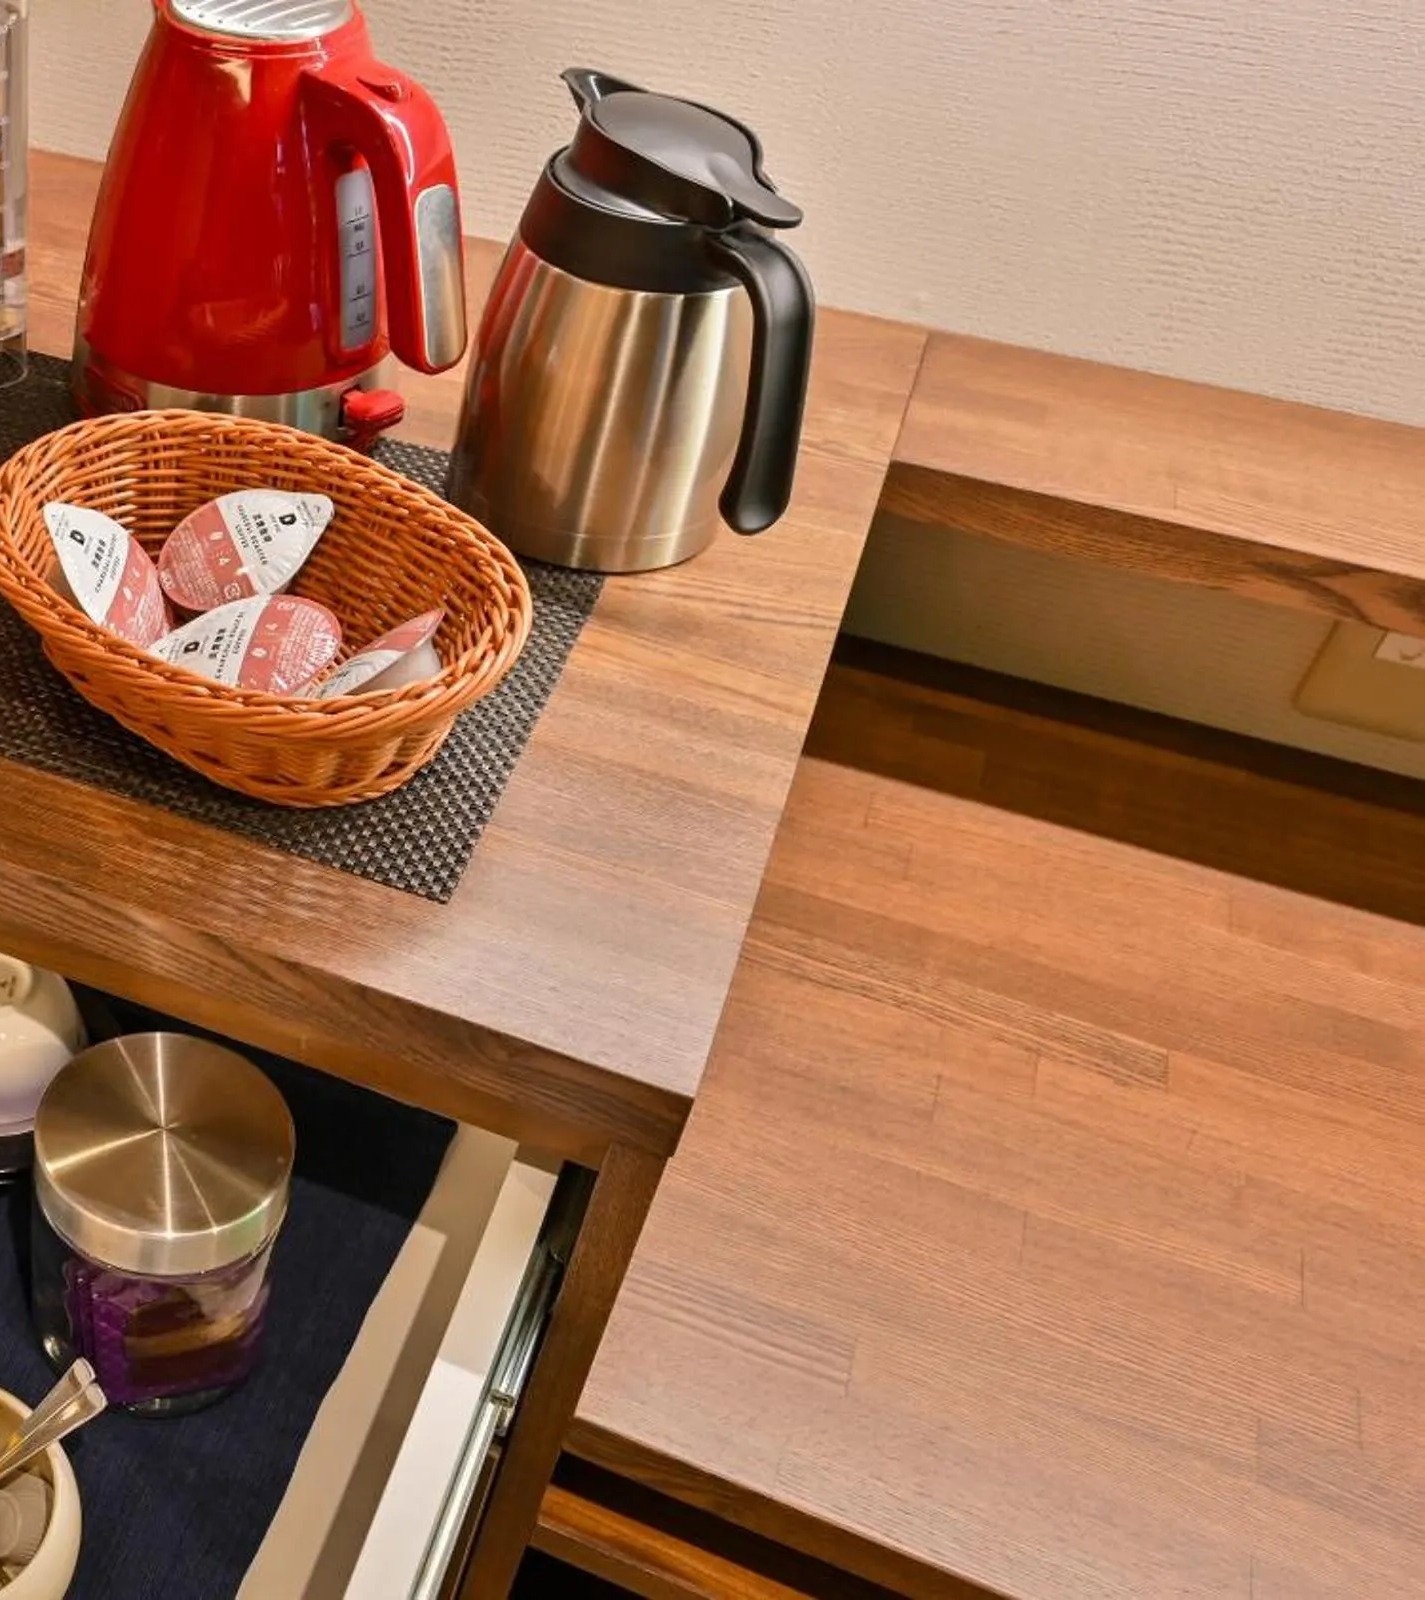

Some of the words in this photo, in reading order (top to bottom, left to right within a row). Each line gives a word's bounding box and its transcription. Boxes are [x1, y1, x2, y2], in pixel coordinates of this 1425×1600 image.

[279, 512, 296, 526] D
[68, 529, 85, 546] D
[182, 641, 199, 652] D
